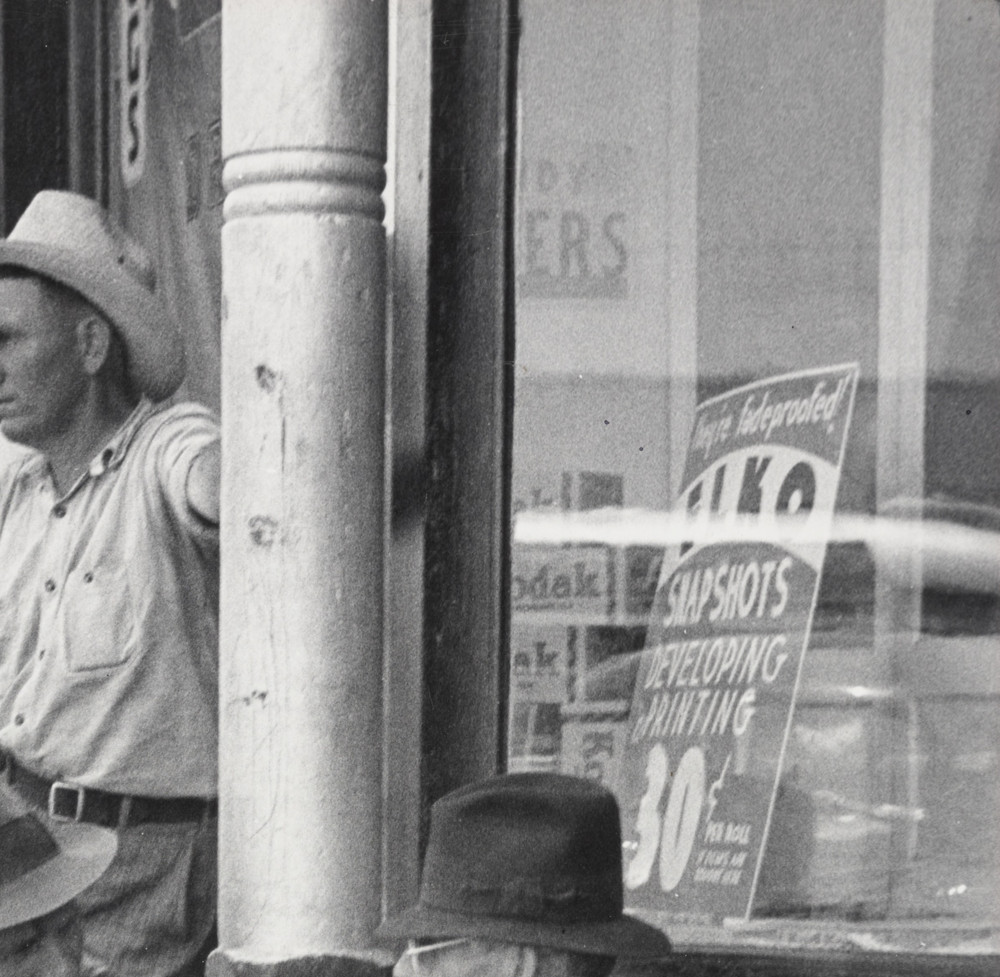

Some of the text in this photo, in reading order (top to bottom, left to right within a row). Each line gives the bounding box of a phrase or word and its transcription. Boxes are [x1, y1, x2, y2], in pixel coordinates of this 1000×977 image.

[525, 210, 629, 279] ERS
[512, 562, 601, 600] odak
[663, 556, 793, 628] SNAPSHOTS
[643, 632, 790, 690] DEVELOPING
[641, 687, 756, 739] PRINTING
